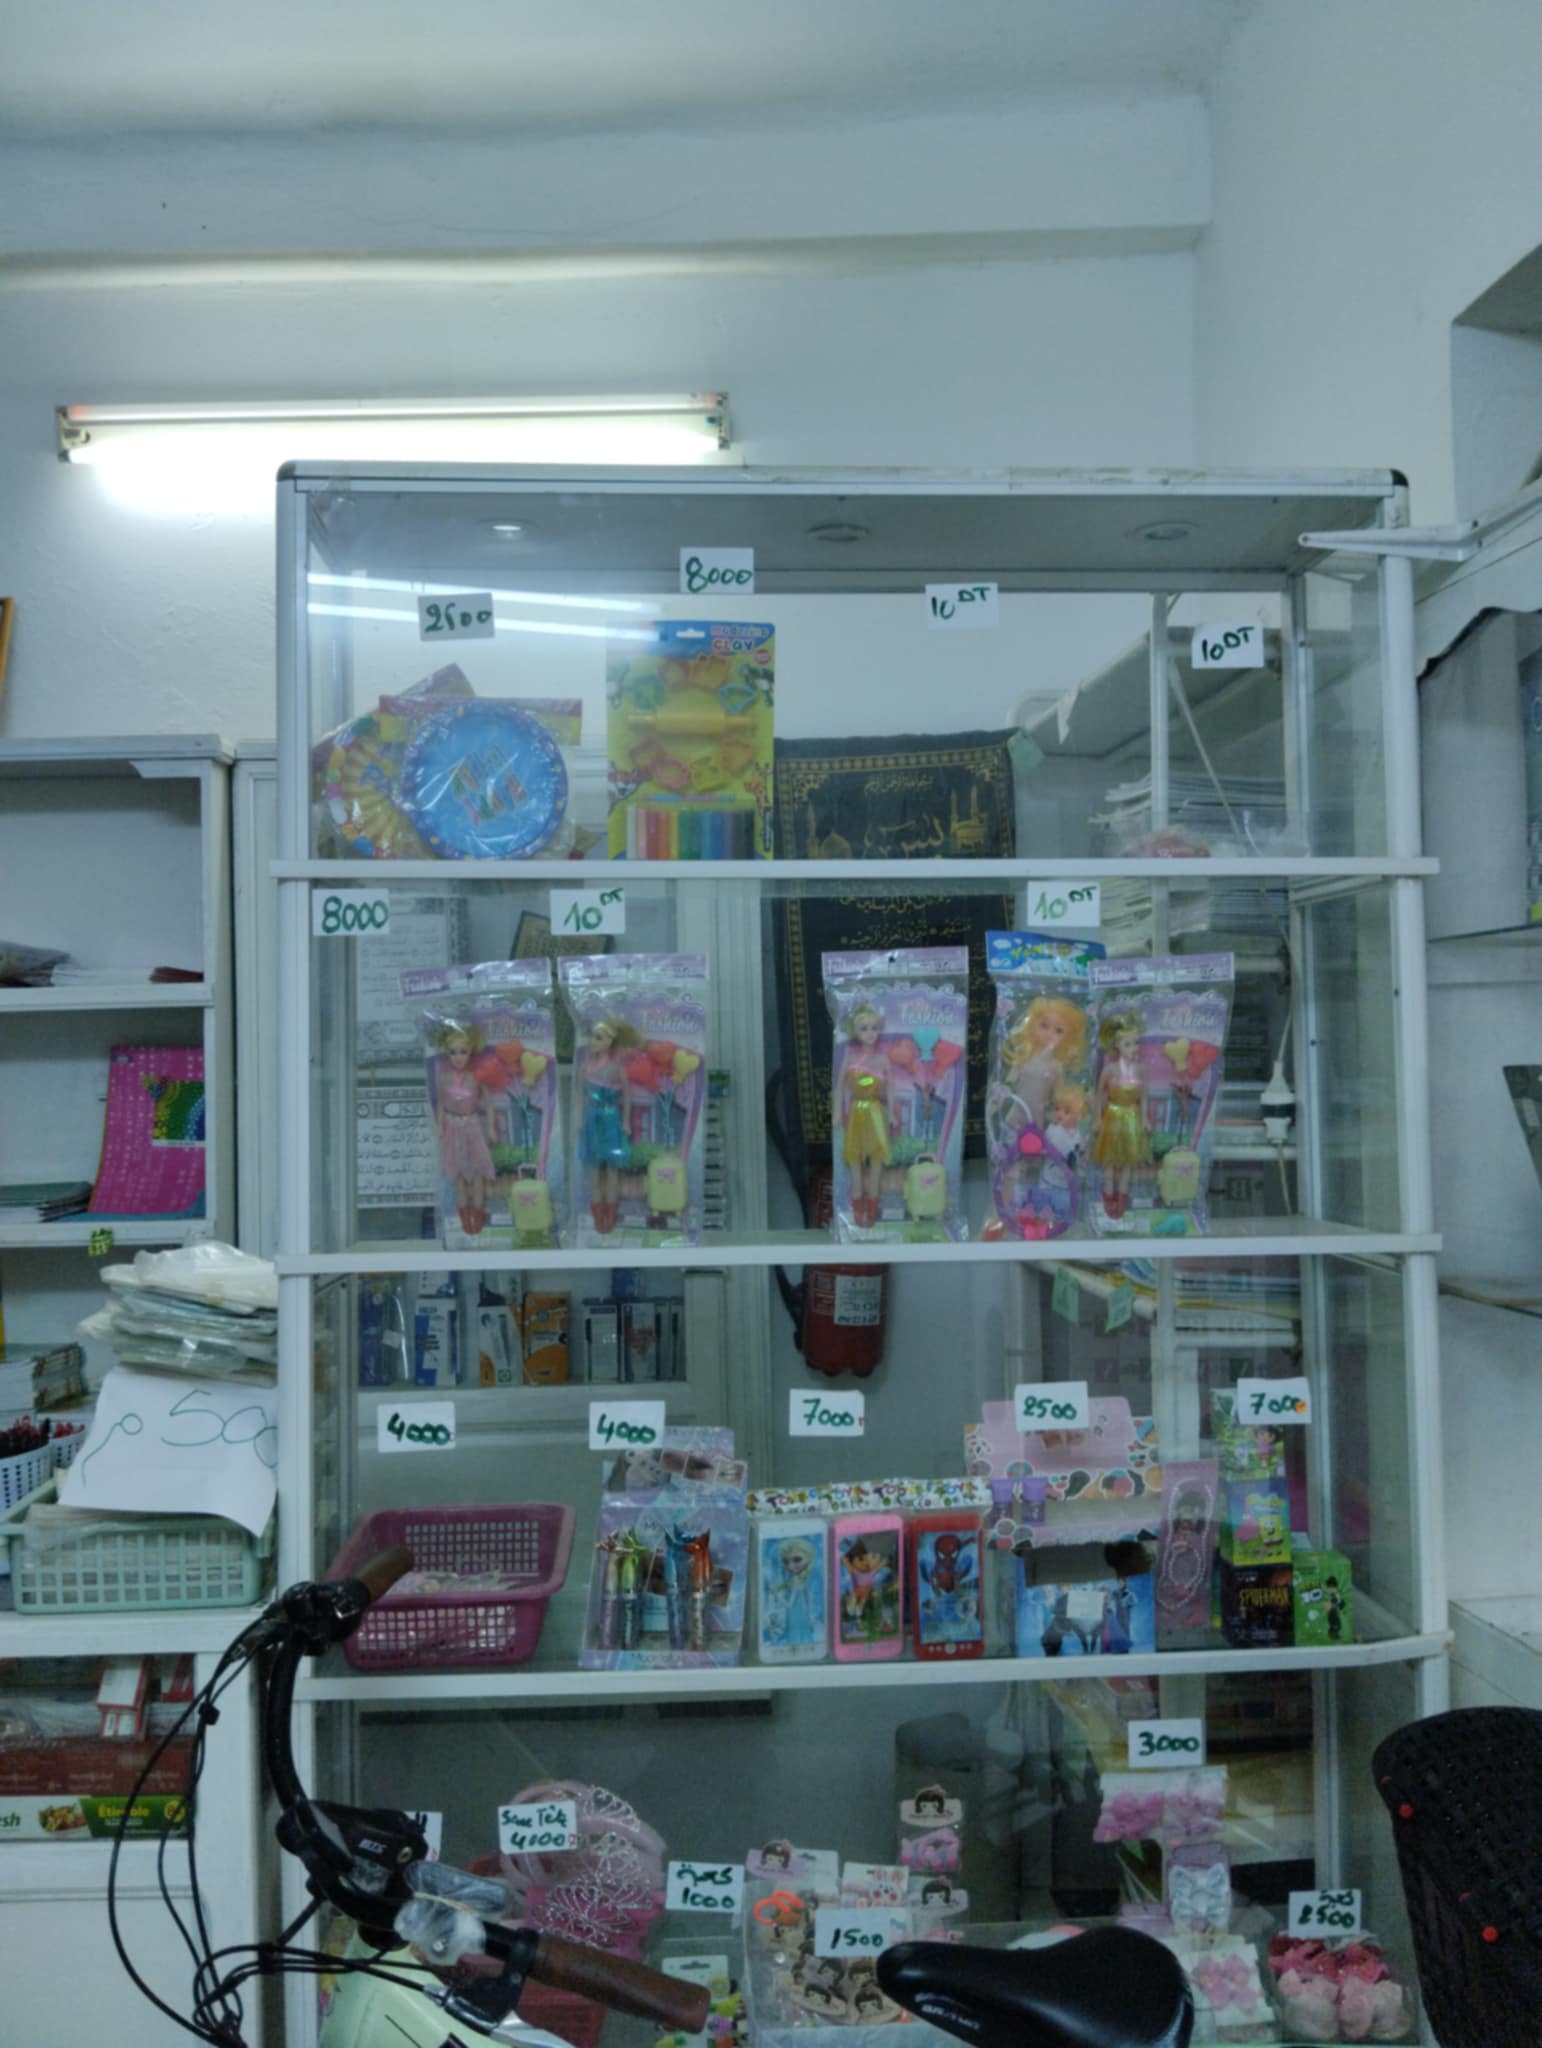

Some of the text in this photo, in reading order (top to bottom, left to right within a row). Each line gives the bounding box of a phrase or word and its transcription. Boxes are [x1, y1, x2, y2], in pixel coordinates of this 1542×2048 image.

[686, 556, 753, 593] 8000
[322, 895, 389, 933] 8000
[803, 1398, 856, 1427] 7000
[1024, 1396, 1077, 1420] 2500
[387, 1413, 452, 1446] 4000
[597, 1414, 656, 1444] 4000
[1138, 1731, 1200, 1756] 3000
[681, 1887, 735, 1909] 1000
[830, 1927, 884, 1950] 1500
